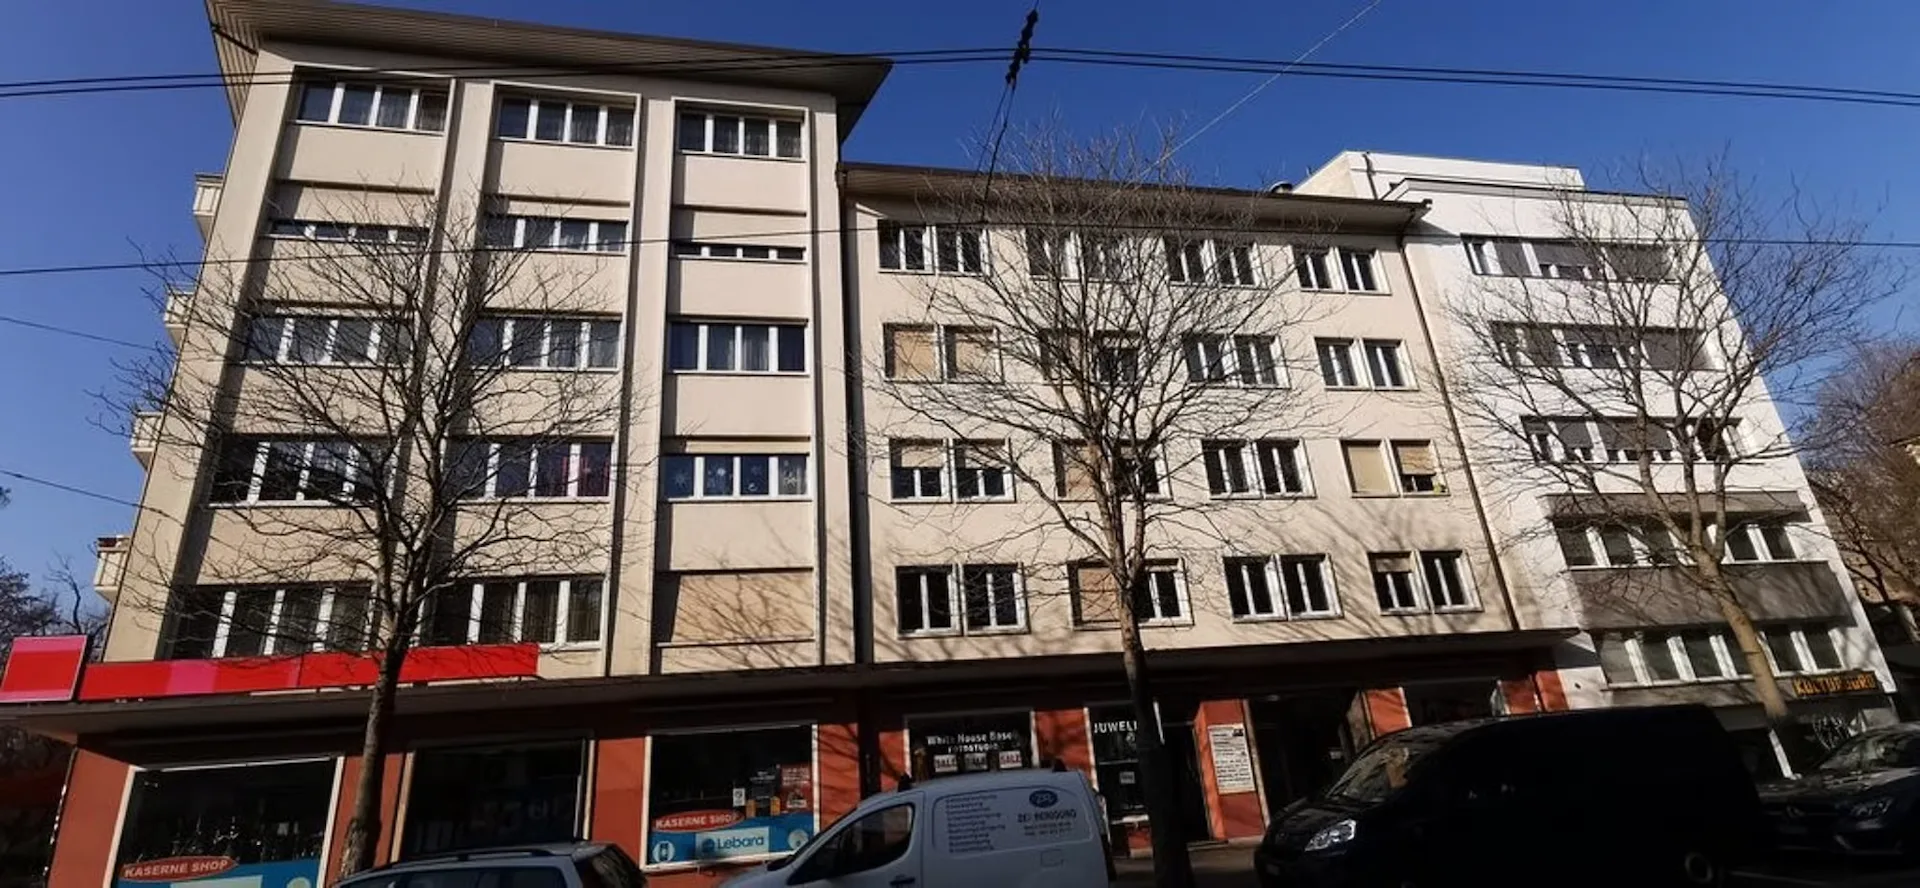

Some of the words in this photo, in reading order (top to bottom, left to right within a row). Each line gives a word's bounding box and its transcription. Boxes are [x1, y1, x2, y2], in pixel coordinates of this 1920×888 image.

[958, 733, 987, 743] House
[655, 817, 705, 829] KASERNE
[709, 813, 738, 824] SHOP
[717, 835, 765, 849] Lebara
[124, 864, 188, 877] KASERNE
[191, 859, 228, 872] SHOP
